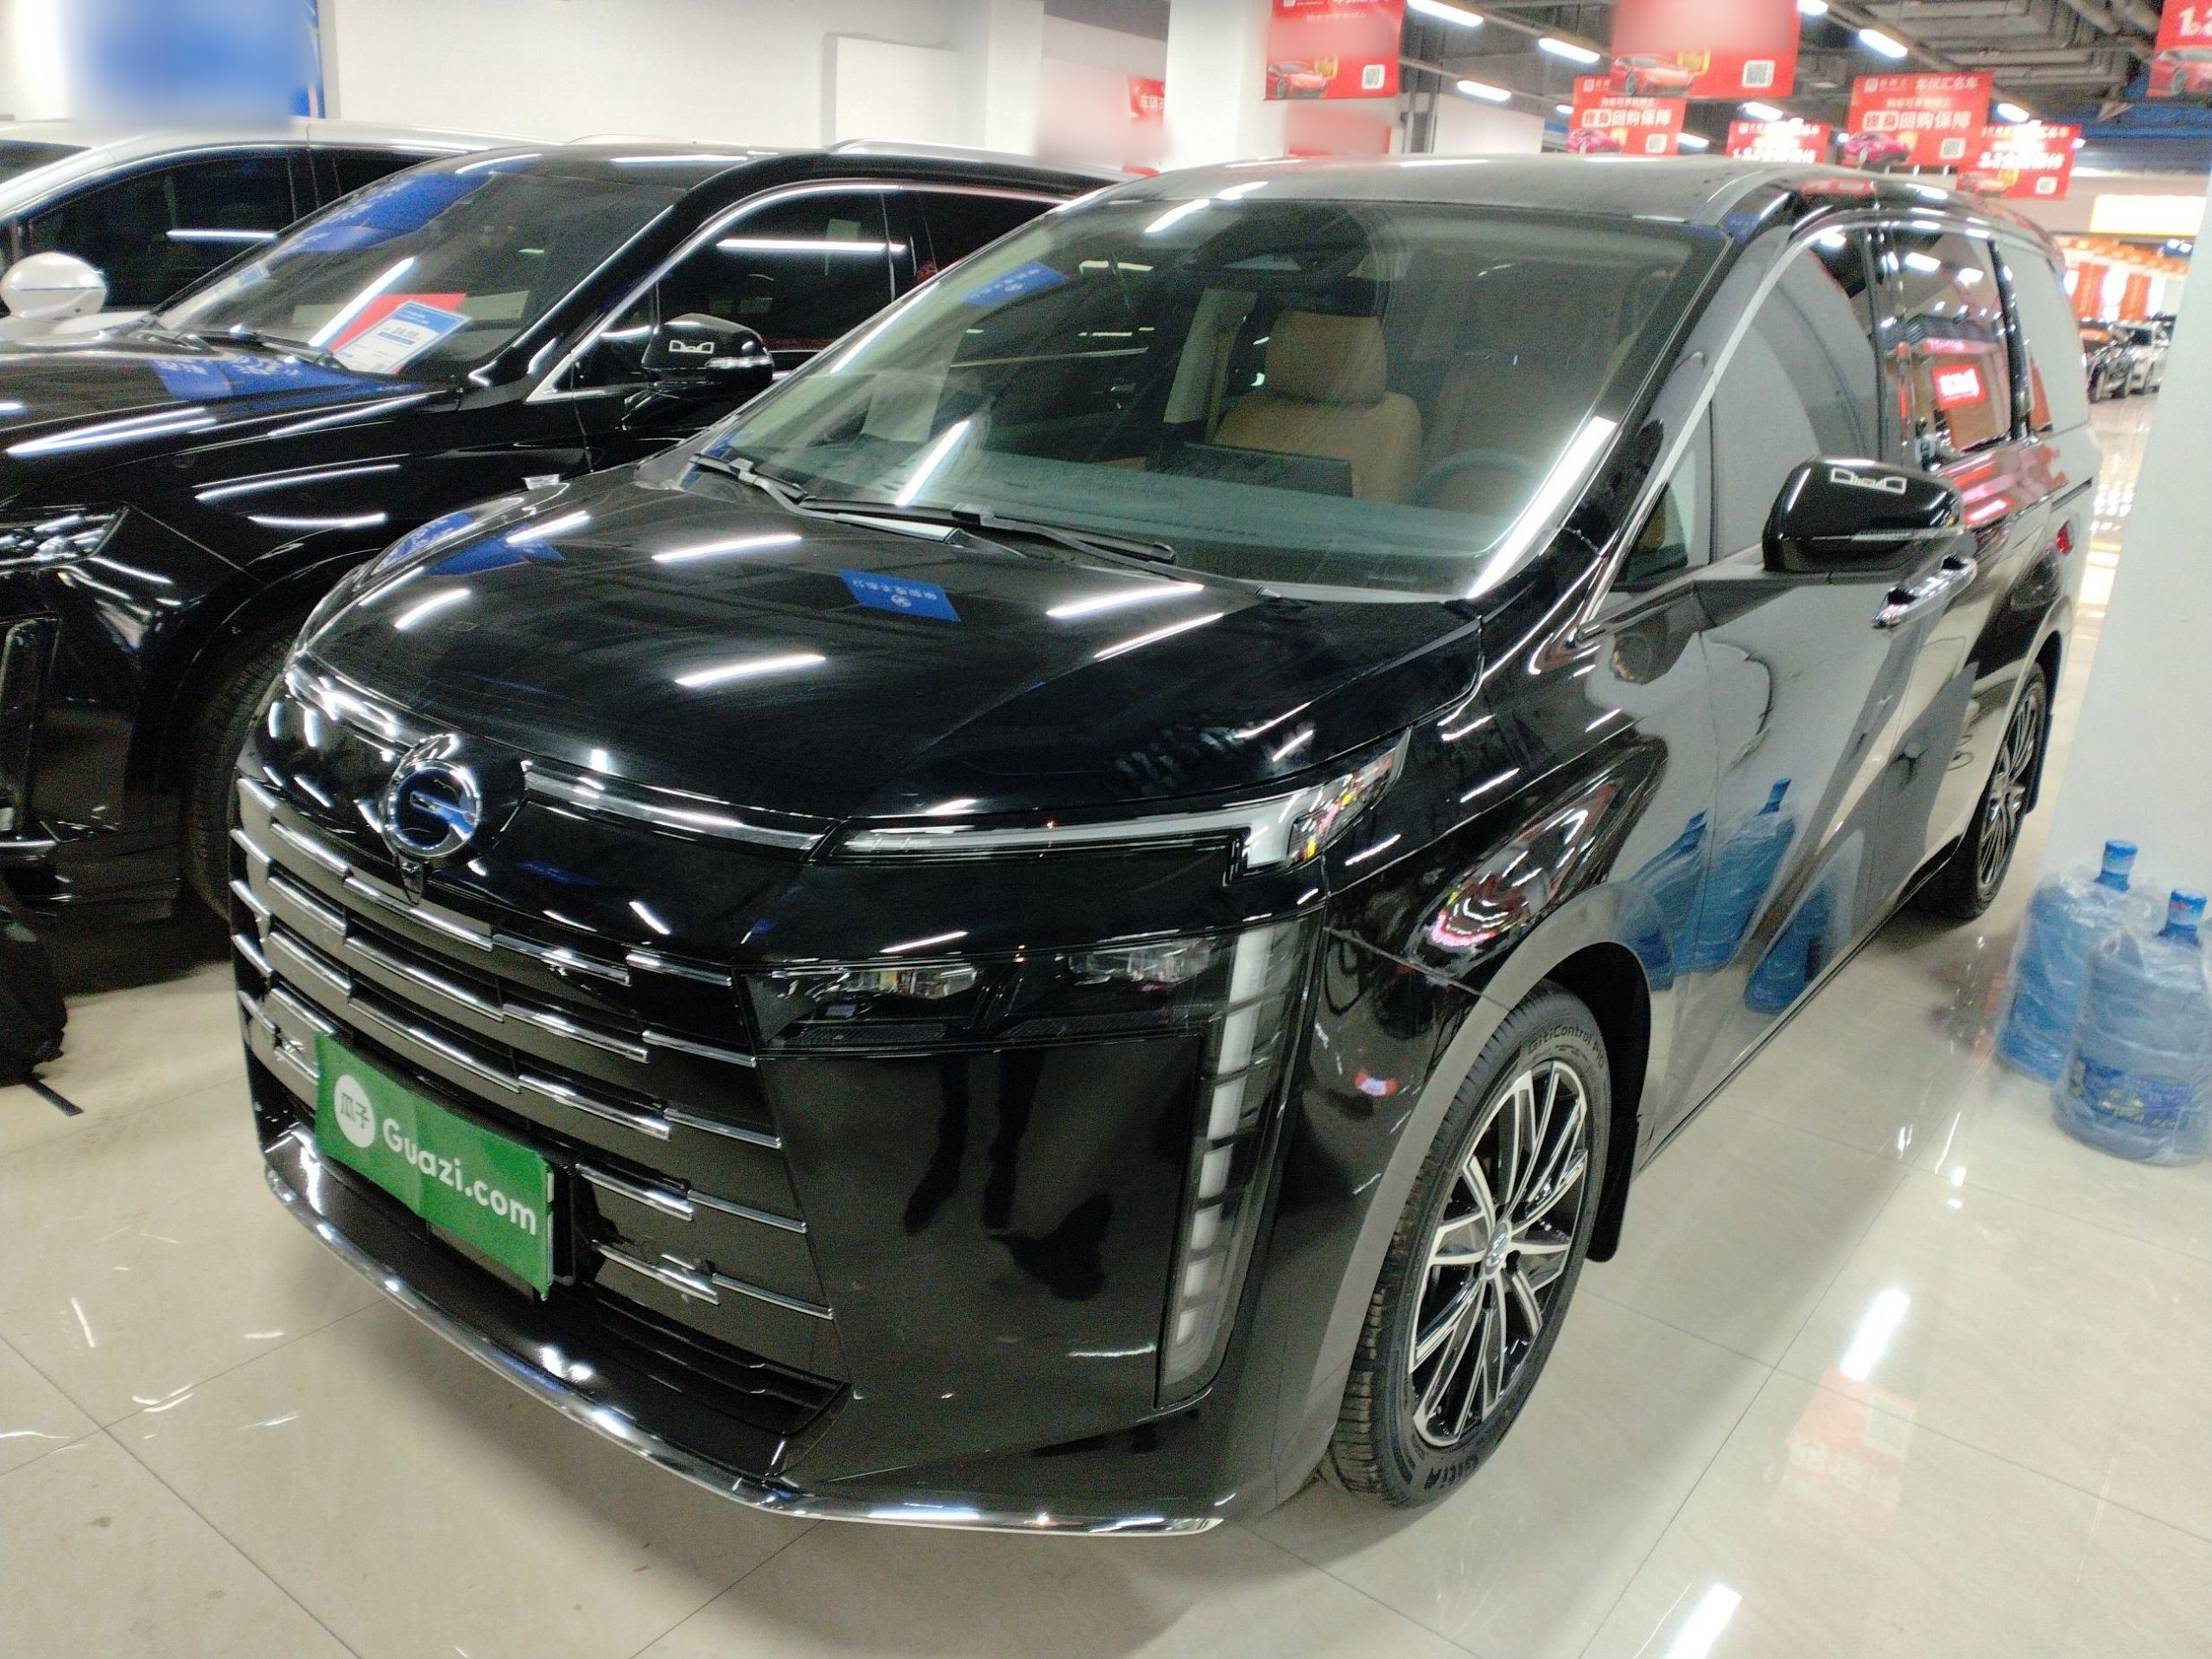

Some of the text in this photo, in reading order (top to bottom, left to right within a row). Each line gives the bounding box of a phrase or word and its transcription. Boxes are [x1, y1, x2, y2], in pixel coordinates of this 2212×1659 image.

[1863, 110, 1971, 131] 终身回购保障
[340, 1092, 370, 1129] 瓜子
[382, 1118, 537, 1235] Guazi.com
